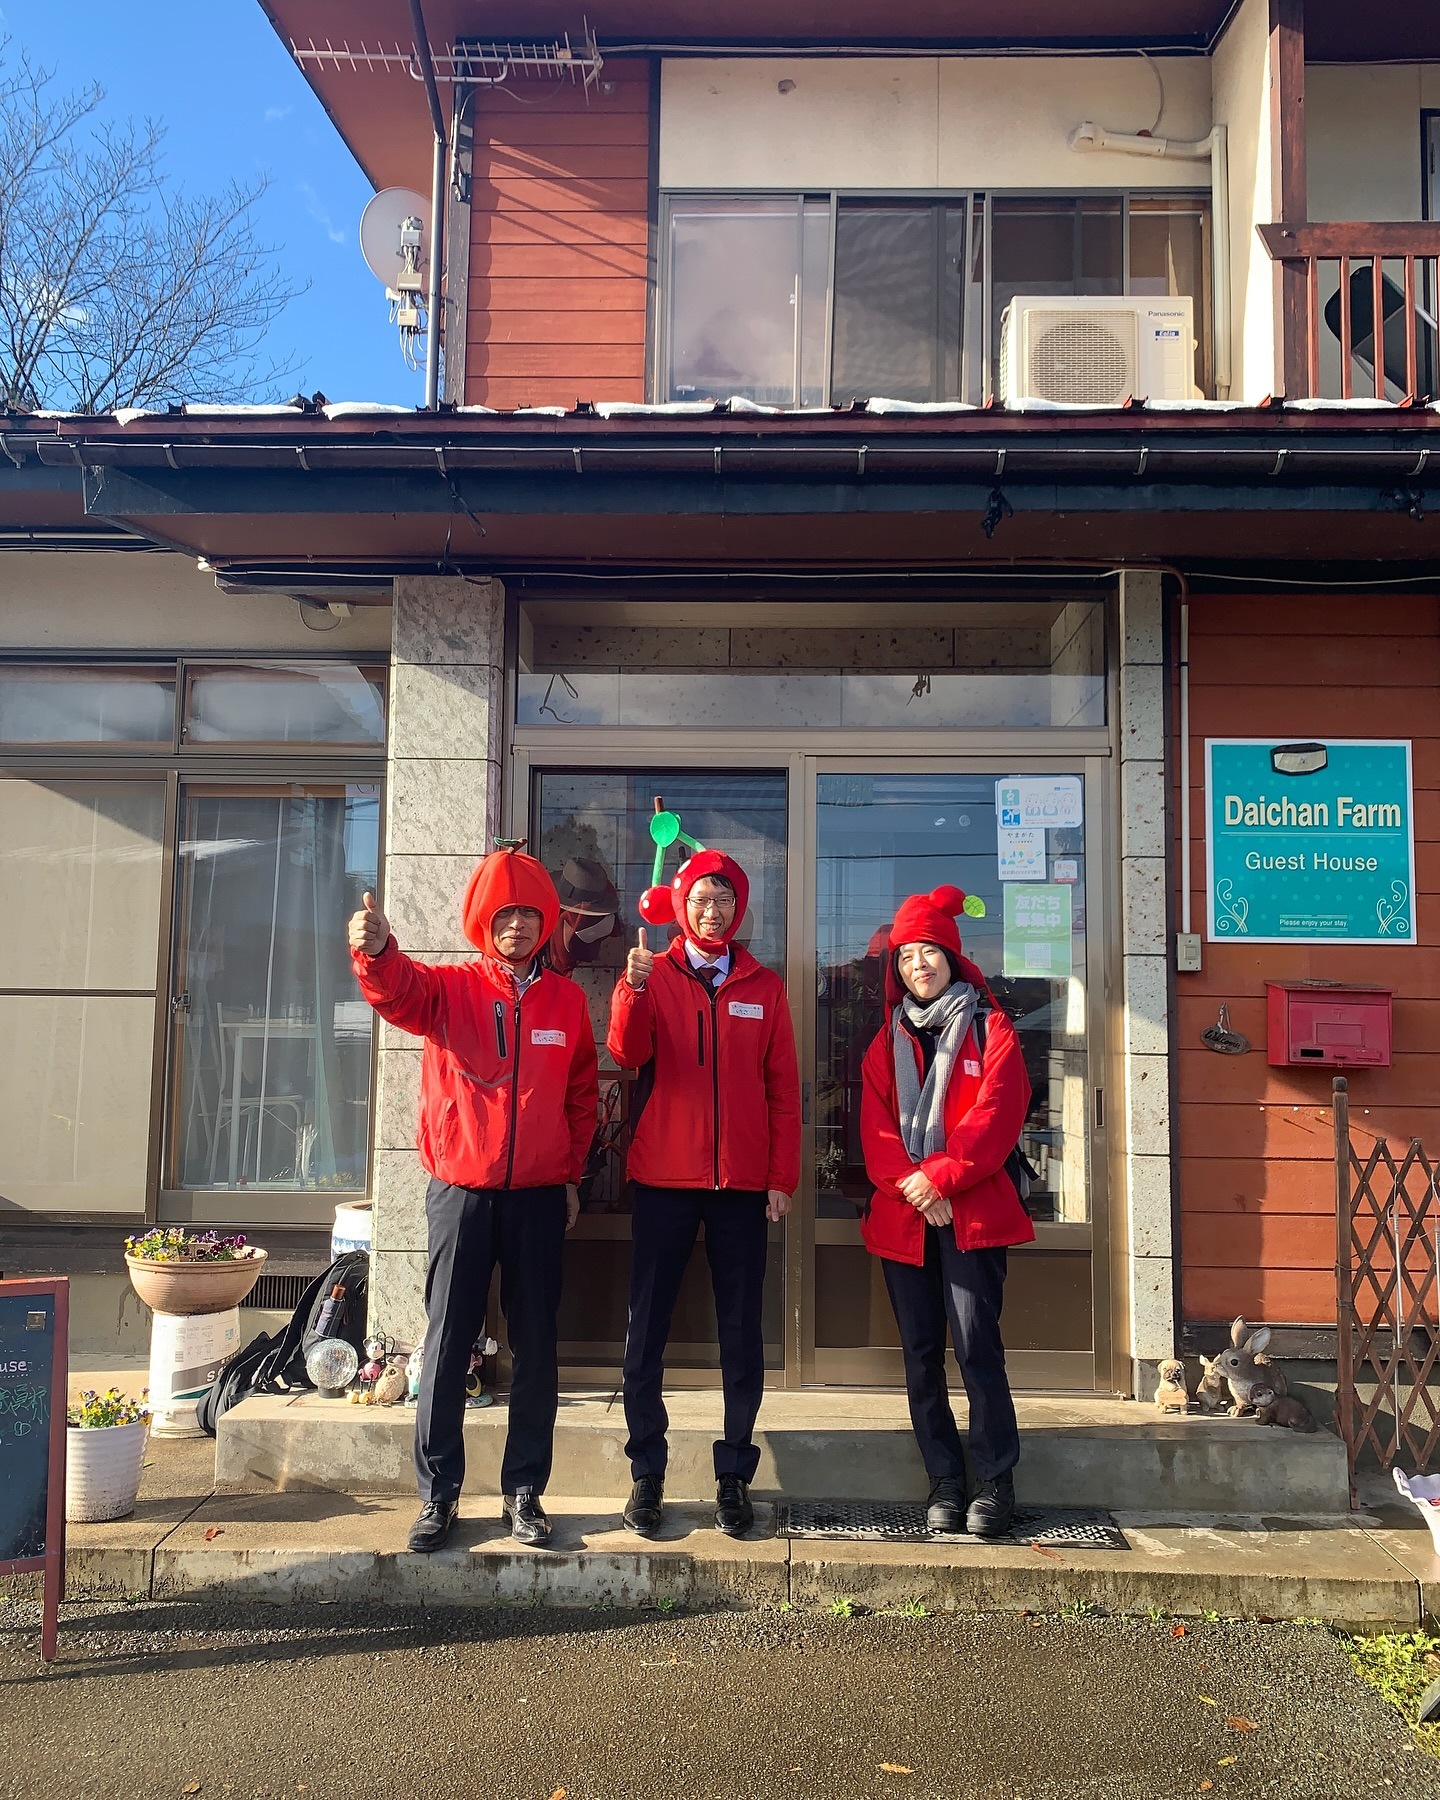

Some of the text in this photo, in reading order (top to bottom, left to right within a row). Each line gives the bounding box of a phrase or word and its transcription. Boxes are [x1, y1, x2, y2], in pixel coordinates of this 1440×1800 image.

[1224, 795, 1401, 828] Daichan Farm
[1007, 831, 1035, 839] やまがた
[1245, 851, 1378, 871] Guest House
[1015, 894, 1061, 911] 友だち
[1015, 912, 1061, 928] 募集中
[1279, 918, 1349, 928] Please enjoy your stay.
